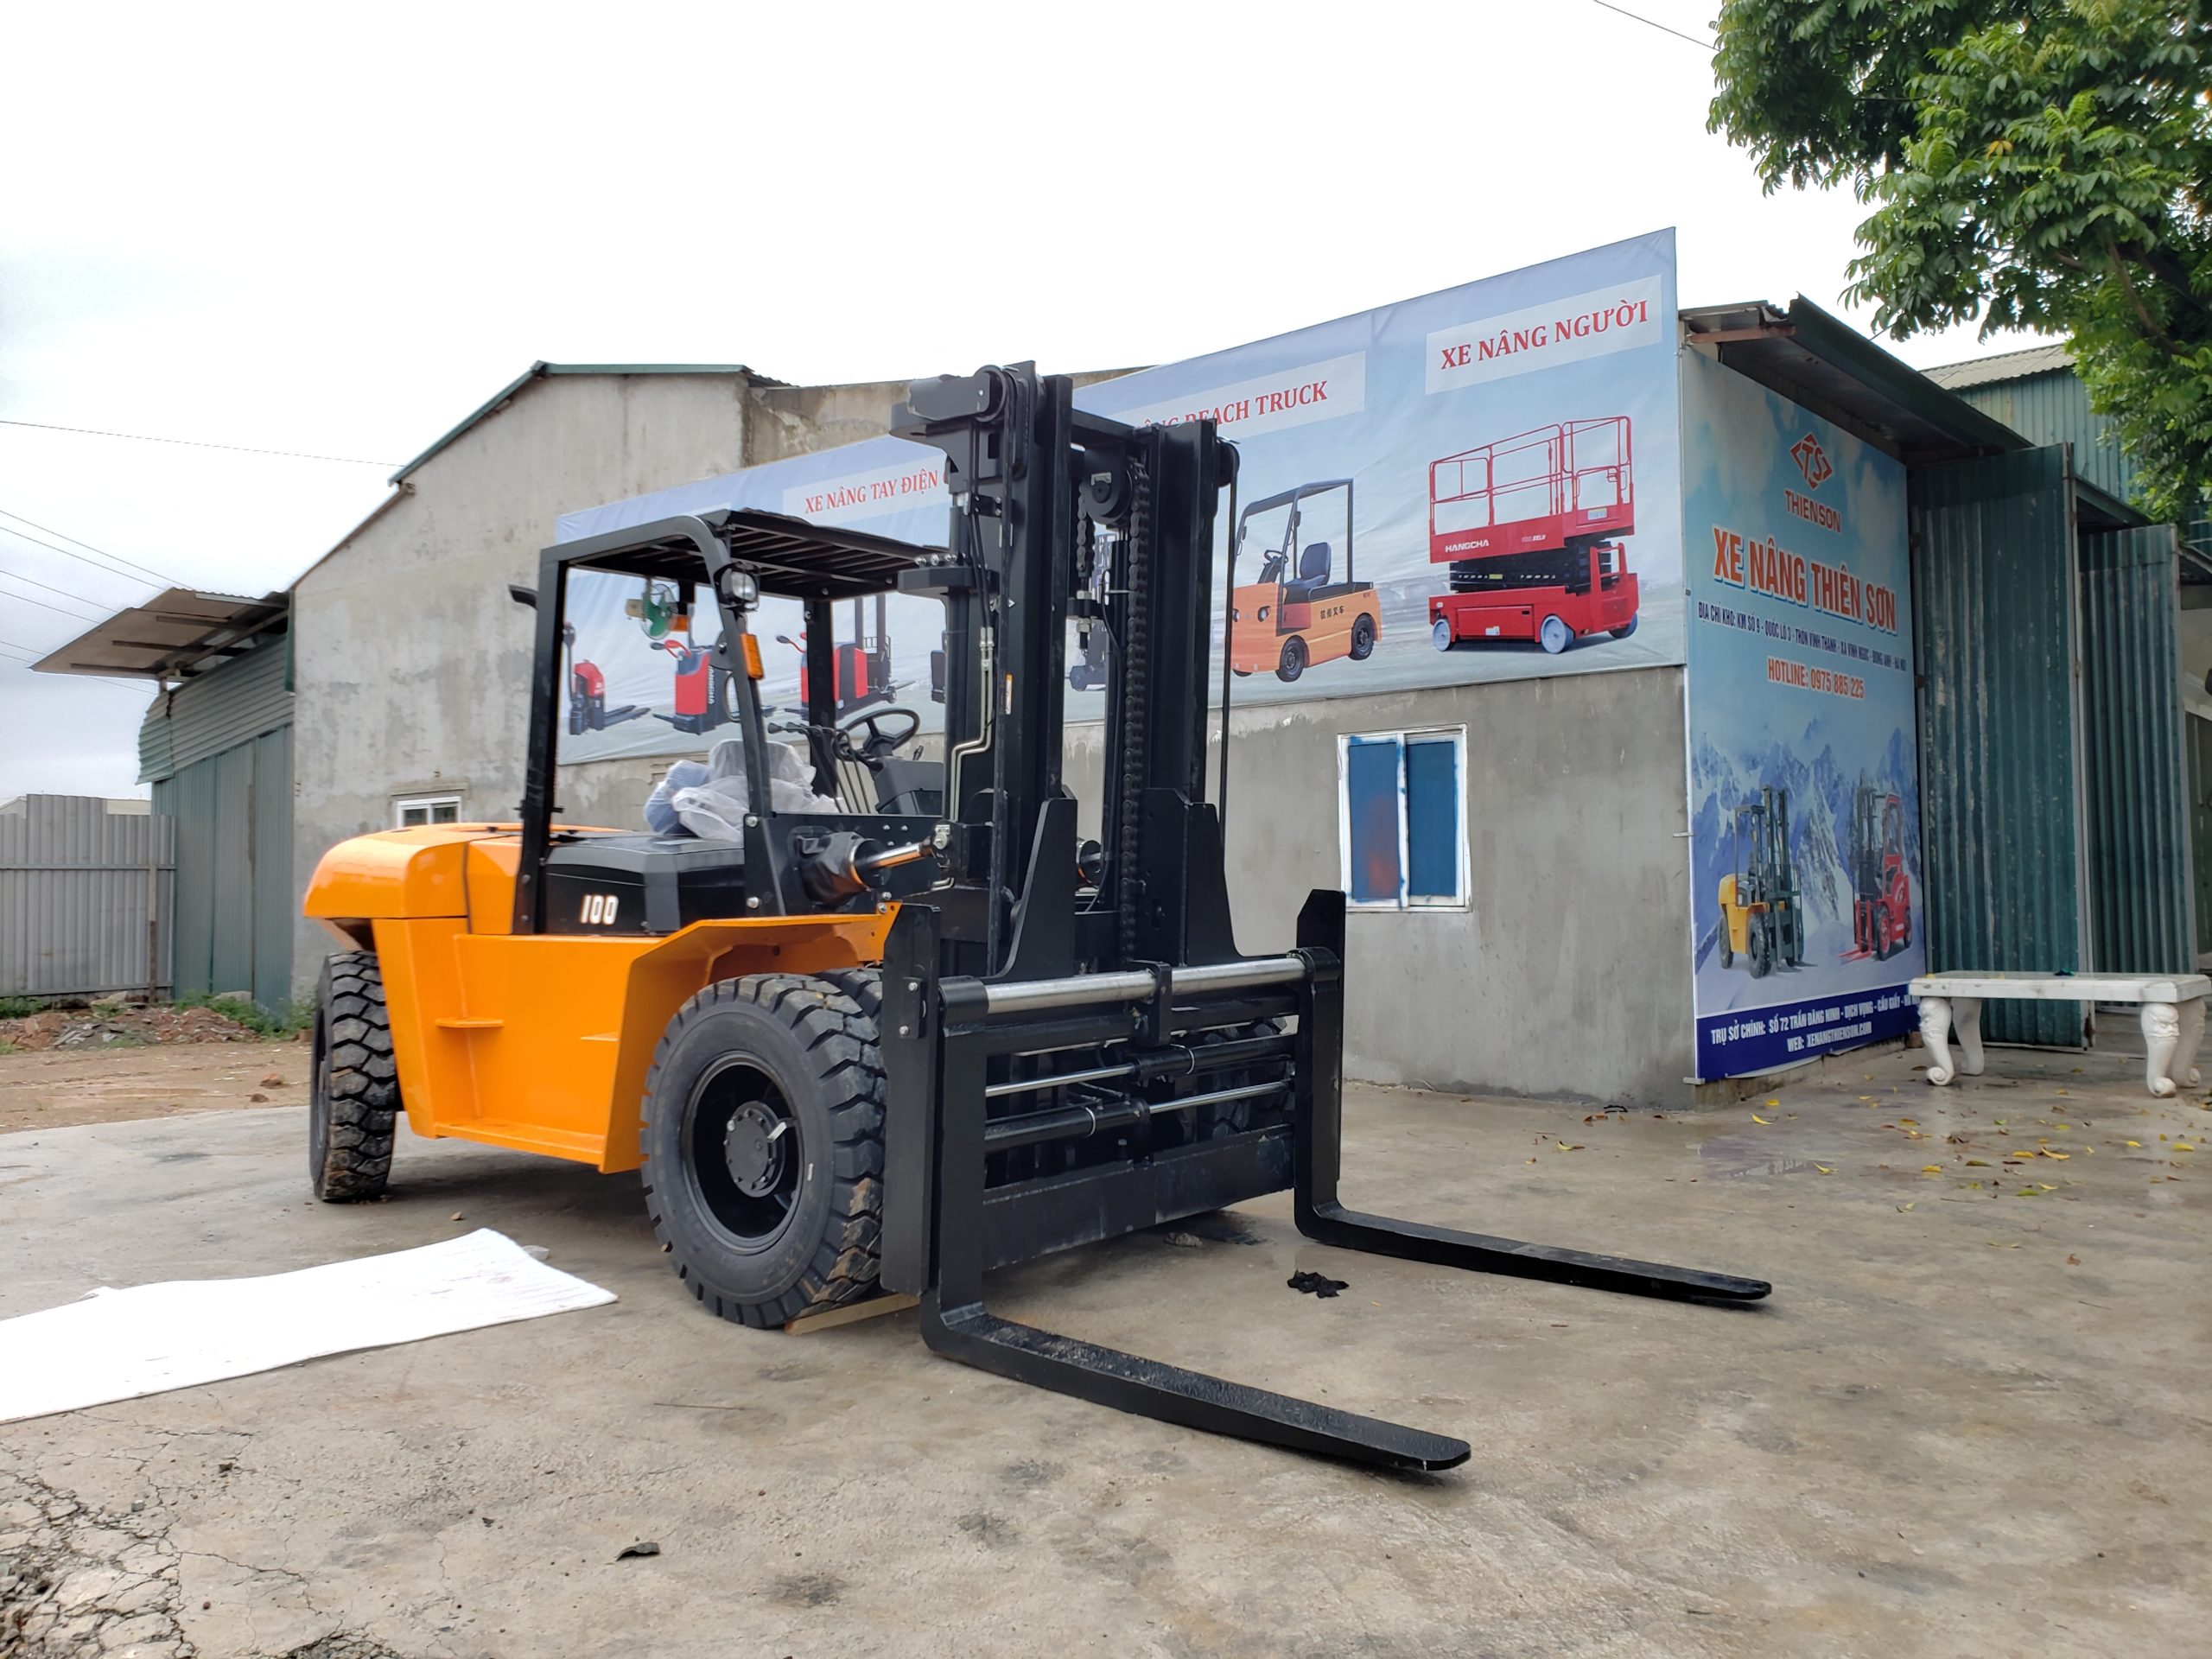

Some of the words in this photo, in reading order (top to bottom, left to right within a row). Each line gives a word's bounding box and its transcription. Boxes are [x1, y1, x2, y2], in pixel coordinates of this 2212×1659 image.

[1440, 344, 1471, 370] XE
[1478, 329, 1548, 361] NÂNG
[1555, 299, 1649, 343] NGƯỜI
[1255, 380, 1328, 416] TRUCK
[805, 495, 823, 514] XE
[827, 486, 867, 511] NÂNG
[871, 479, 899, 500] TAY
[901, 467, 939, 495] ĐIỆN
[1783, 489, 1842, 533] THIENSON
[1445, 538, 1490, 553] HANGCHA
[1713, 526, 1745, 586] XE
[1748, 536, 1808, 605] NÂNG
[1810, 562, 1863, 621] THIÊN
[1866, 582, 1897, 632] SƠN
[1767, 657, 1808, 688] HOTLINE:
[1810, 667, 1832, 692] 0975
[1834, 673, 1849, 696] 885
[1850, 677, 1865, 700] 225
[580, 894, 620, 925] 100
[1711, 1027, 1727, 1046] TRỤ
[1728, 1020, 1739, 1041] SỞ
[1769, 1013, 1779, 1034] SỐ
[1780, 1017, 1789, 1032] 72
[1786, 1036, 1805, 1052] WEB:
